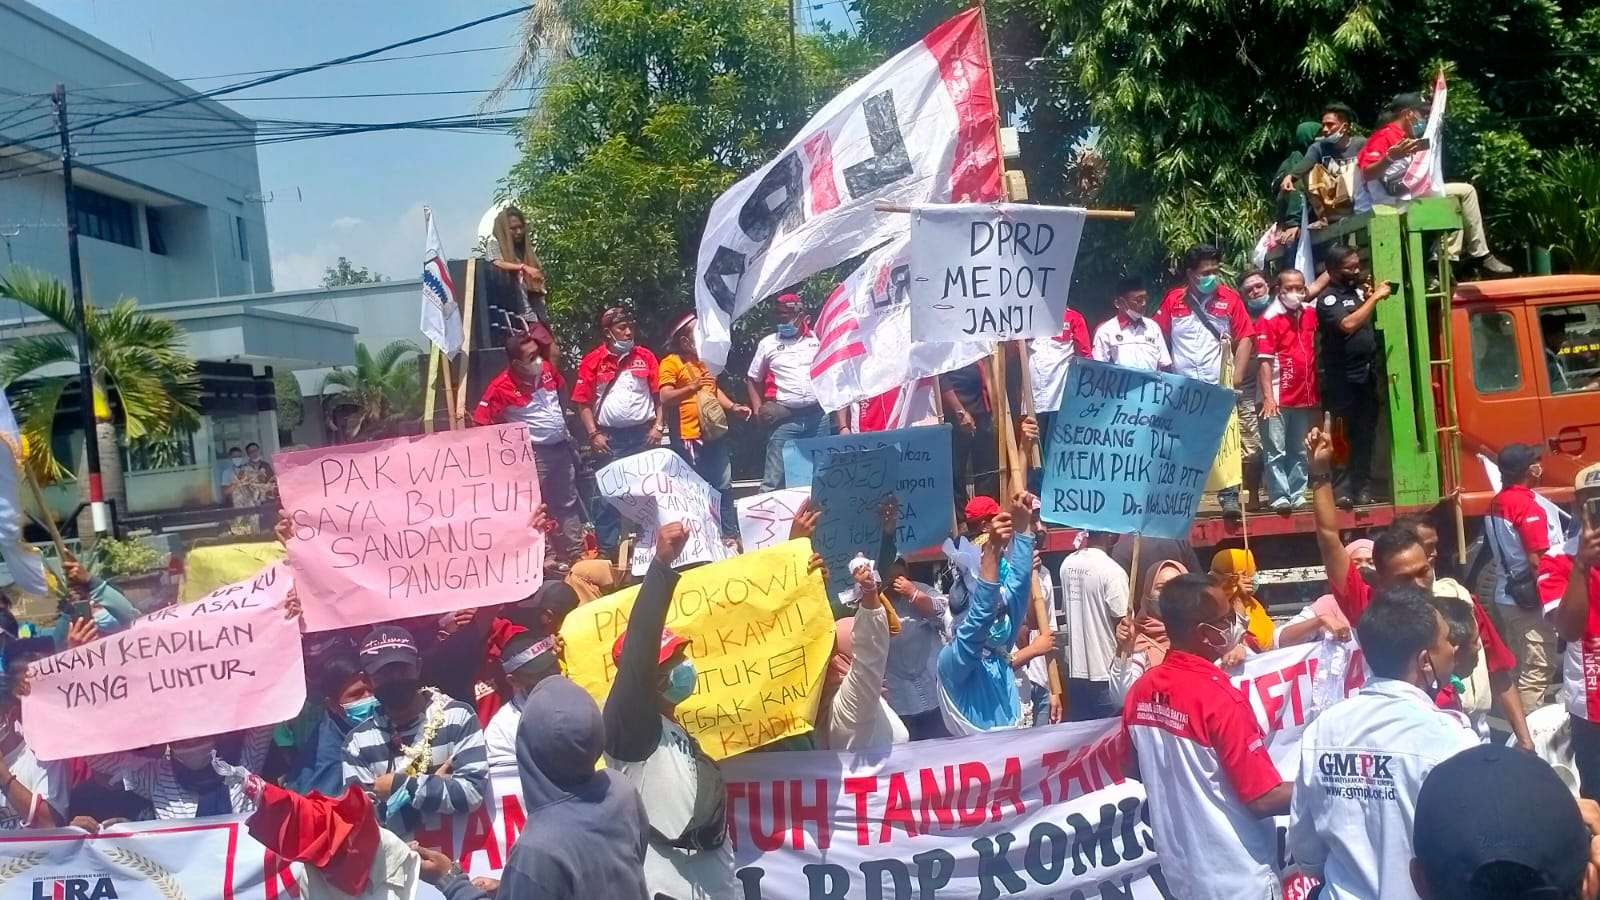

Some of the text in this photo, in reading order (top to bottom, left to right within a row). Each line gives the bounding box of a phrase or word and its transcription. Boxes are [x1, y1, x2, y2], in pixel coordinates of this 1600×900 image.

[970, 221, 1055, 257] DPRD
[941, 265, 1056, 300] MEDOT
[962, 305, 1034, 335] JANJI
[1076, 367, 1209, 416] BARU TERJADI
[1150, 430, 1181, 460] PLT
[320, 443, 492, 497] PAK WALI
[1157, 462, 1175, 485] 128
[1178, 463, 1204, 488] PTT
[292, 481, 533, 541] SAYA BUTUH
[1052, 488, 1107, 513] RSUD
[1121, 492, 1142, 516] Dr.
[330, 517, 493, 569] SANDANG
[250, 566, 277, 594] KU
[190, 598, 262, 617] ASAL
[594, 607, 635, 642] PA
[117, 622, 254, 667] KEADILAN
[57, 659, 256, 710] YANG LUNTUR.
[1584, 653, 1598, 690] NKRI
[1319, 752, 1394, 779] GMPK
[844, 756, 1025, 846] TANDA
